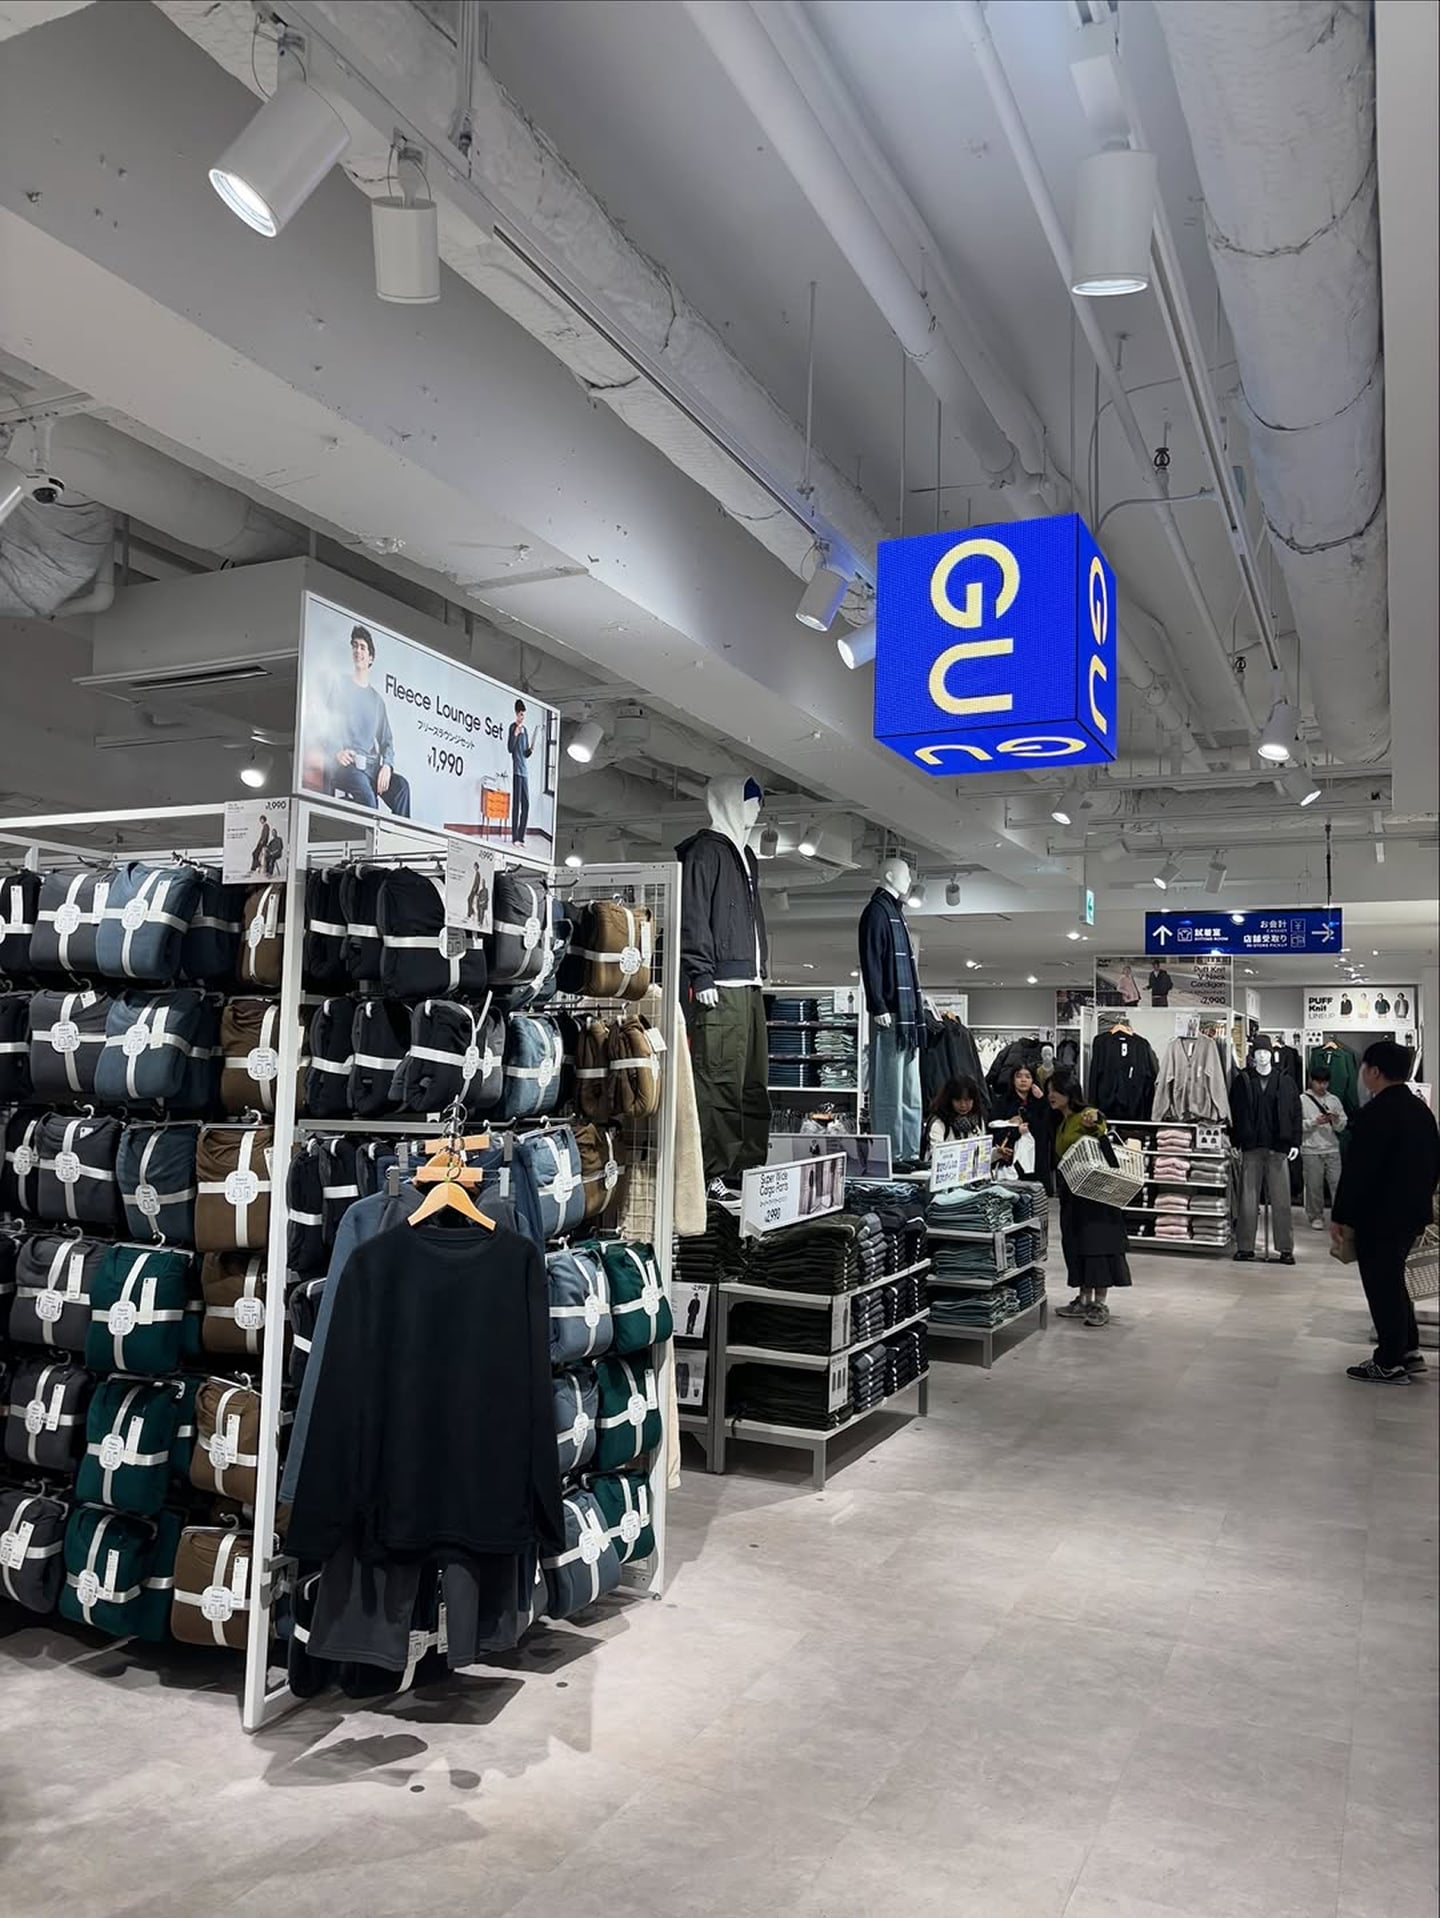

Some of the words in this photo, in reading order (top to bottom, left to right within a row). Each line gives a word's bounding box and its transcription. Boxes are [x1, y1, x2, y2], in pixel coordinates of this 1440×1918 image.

[928, 538, 1021, 715] GU
[1088, 555, 1108, 735] GU
[385, 673, 431, 710] Fleece
[436, 695, 481, 732] Lounge
[484, 716, 504, 740] Set
[416, 720, 476, 750] フリースラウンジセット
[914, 735, 1087, 765] GU
[427, 746, 464, 777] ¥1,990
[1243, 934, 1288, 944] 店舗受取り
[1260, 919, 1287, 929] お会計
[1190, 980, 1226, 989] Cardigan
[1308, 996, 1333, 1004] PUFF
[1308, 1004, 1327, 1012] Knit
